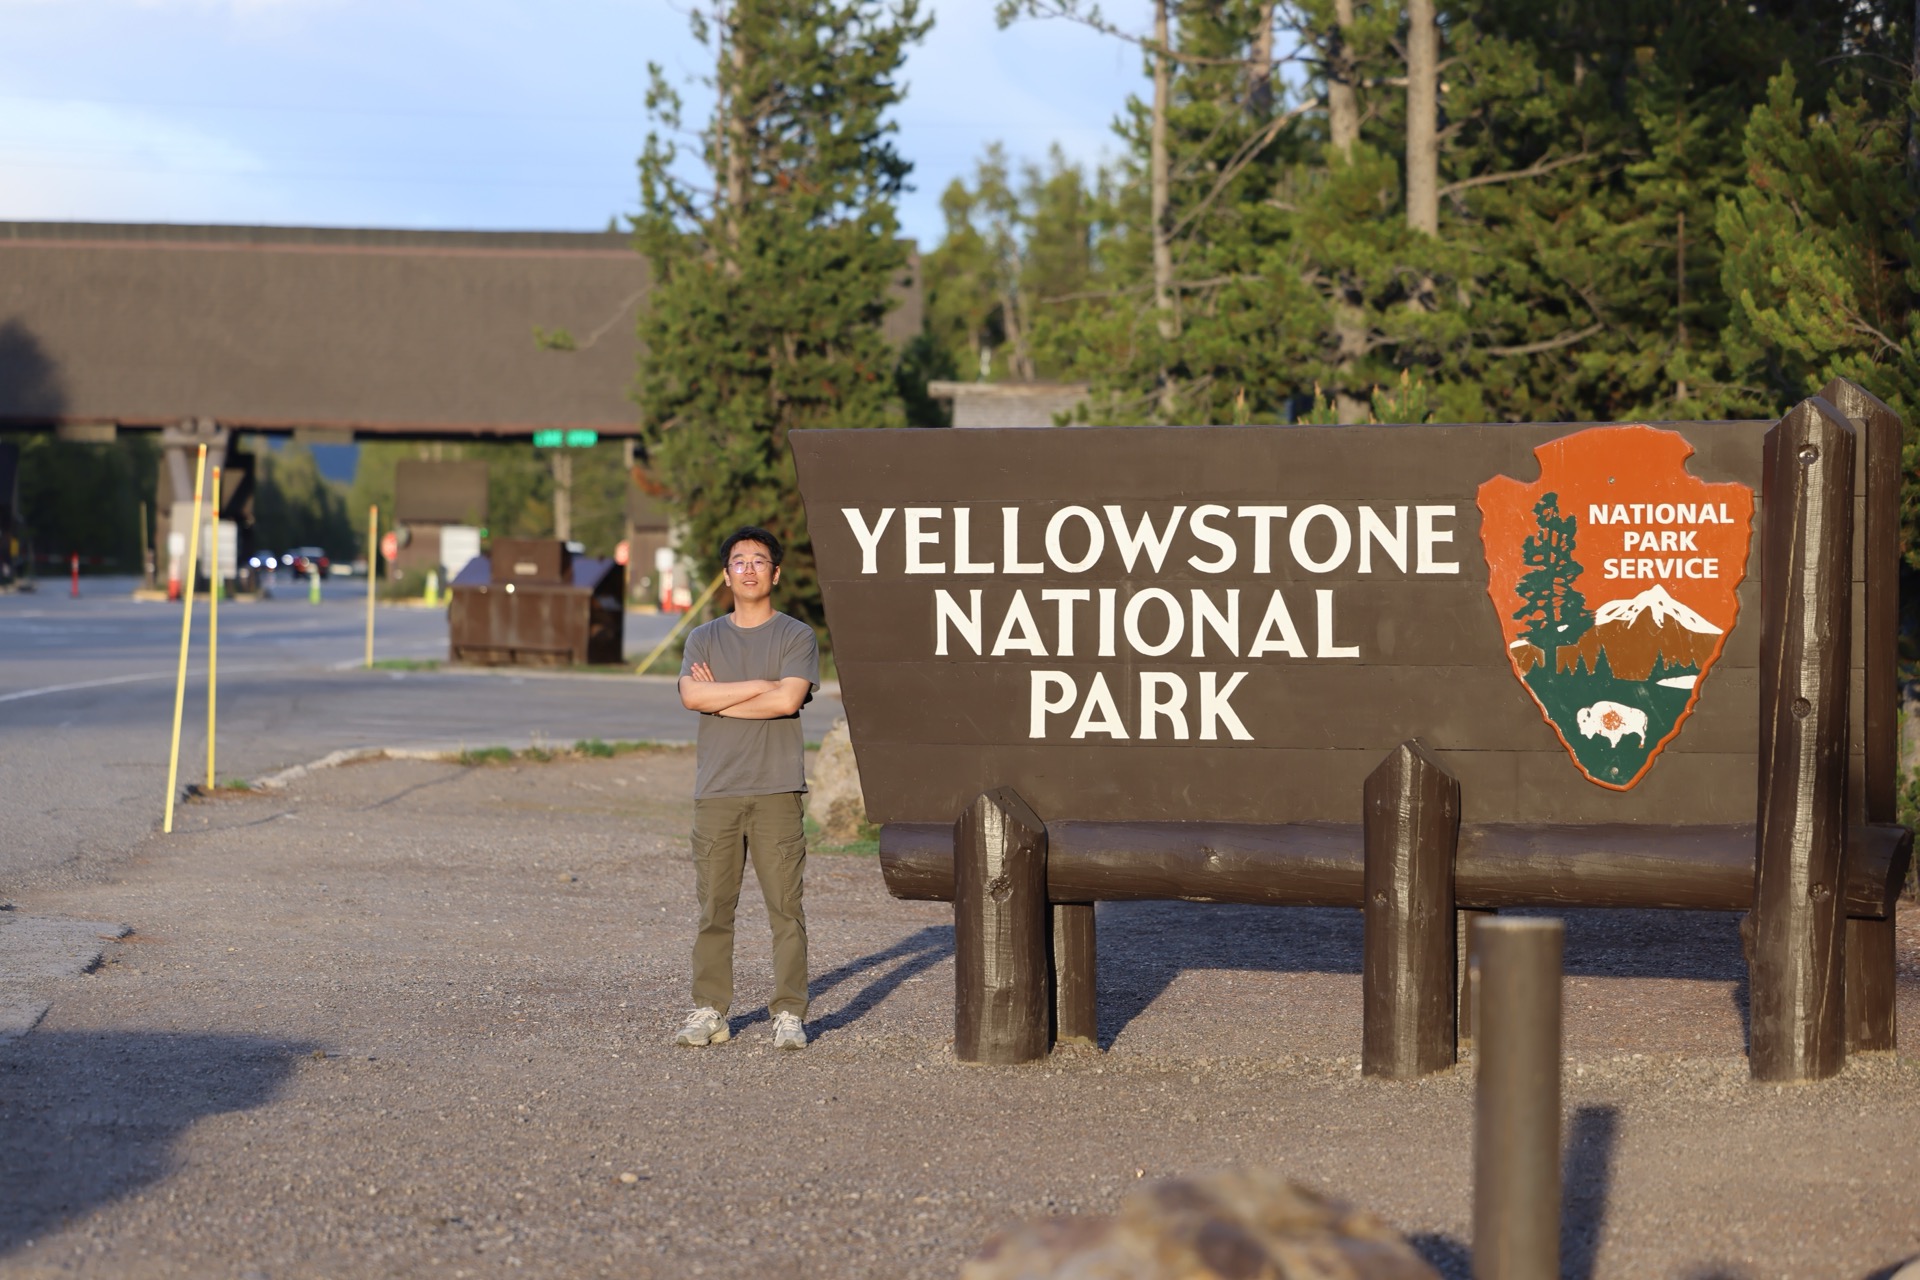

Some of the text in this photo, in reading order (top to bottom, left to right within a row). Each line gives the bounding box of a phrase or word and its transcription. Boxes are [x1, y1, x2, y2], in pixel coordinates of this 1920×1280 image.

[1590, 504, 1734, 525] NATIONAL
[842, 504, 1459, 574] YELLOWSTONE
[1624, 531, 1698, 551] PARK
[1604, 558, 1718, 579] SERVICE
[935, 588, 1359, 658] NATIONAL
[1029, 671, 1254, 740] PARK
